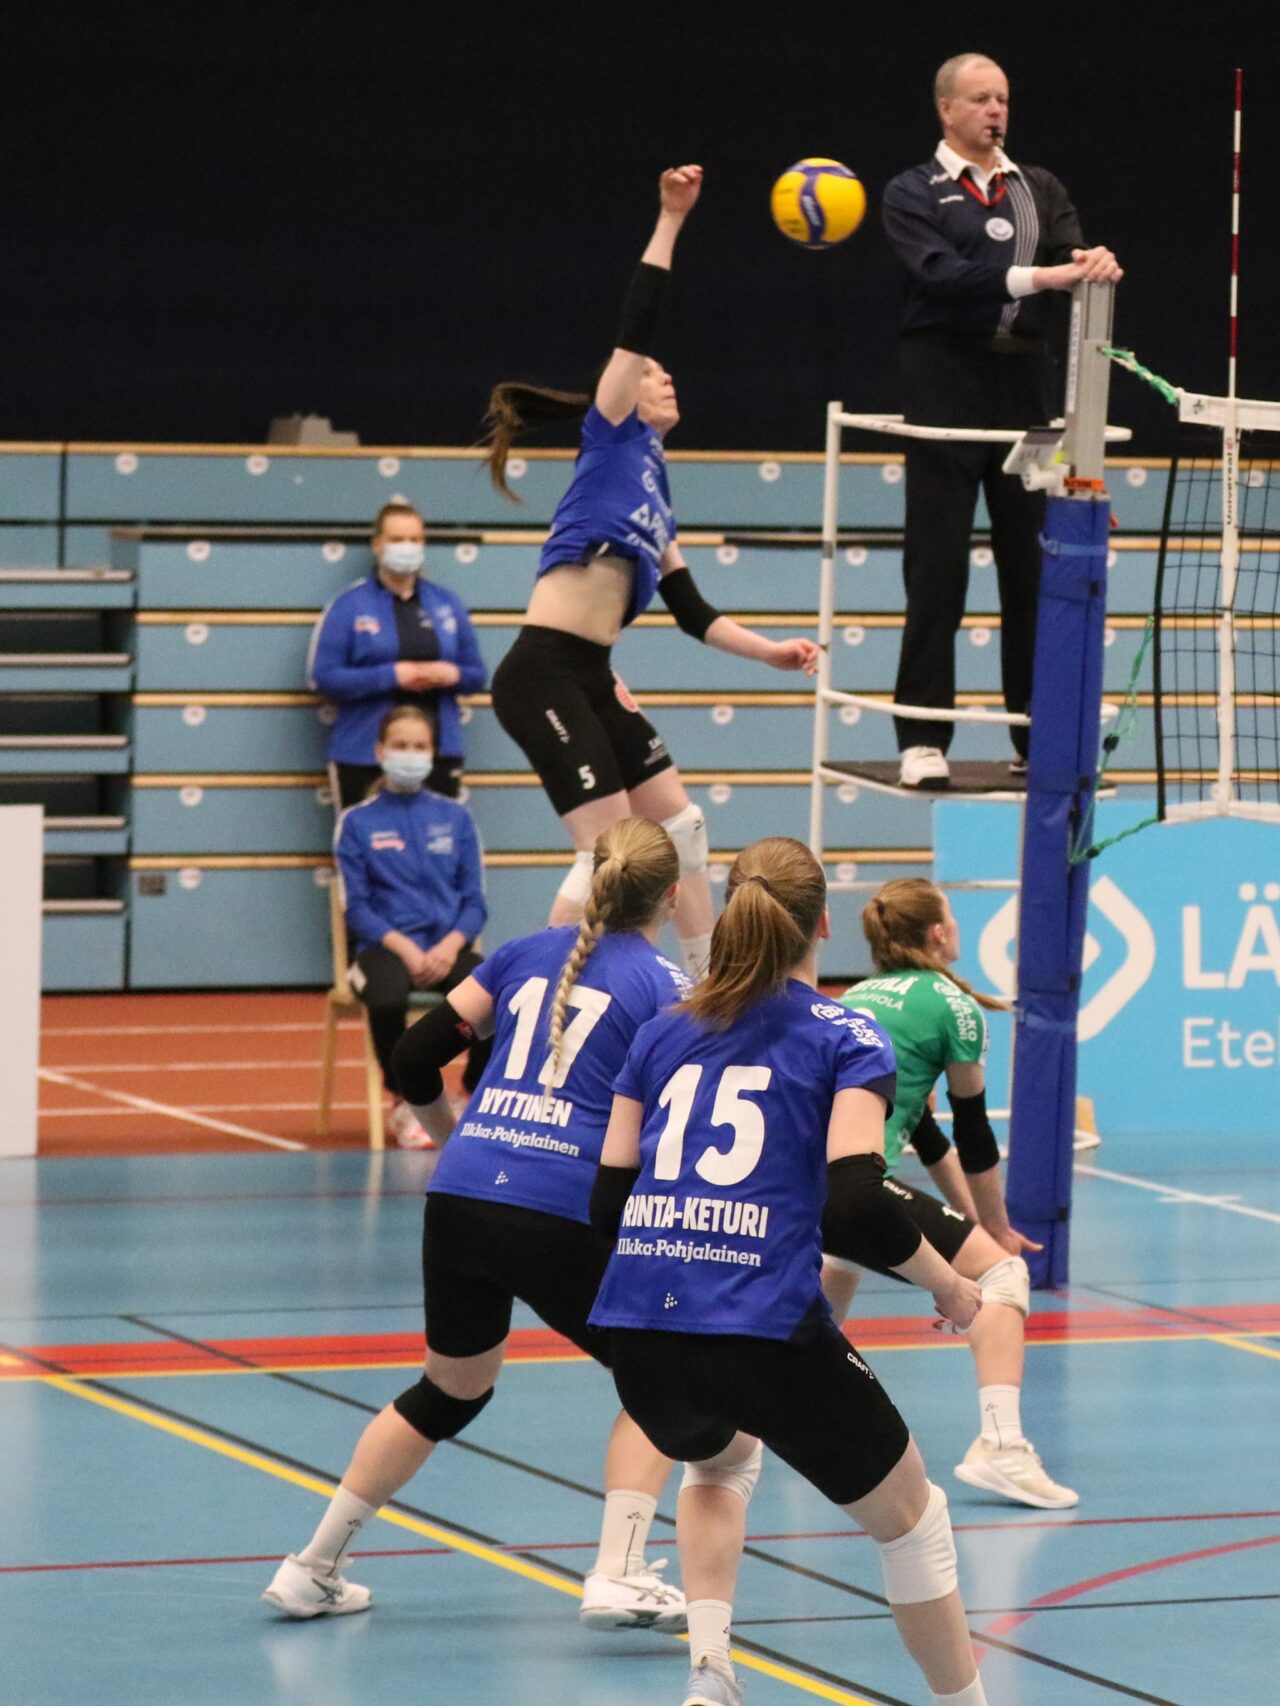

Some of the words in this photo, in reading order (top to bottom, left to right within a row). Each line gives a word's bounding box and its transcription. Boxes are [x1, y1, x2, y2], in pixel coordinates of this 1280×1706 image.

[578, 764, 596, 790] 5
[504, 976, 612, 1089] 17
[477, 1087, 573, 1127] HYTTINEN
[654, 1064, 771, 1186] 15
[460, 1122, 580, 1157] Ilkka-Pohjalainen
[622, 1194, 769, 1238] RINTA-KETURI
[617, 1238, 761, 1266] Ilkka-Pohjalainen
